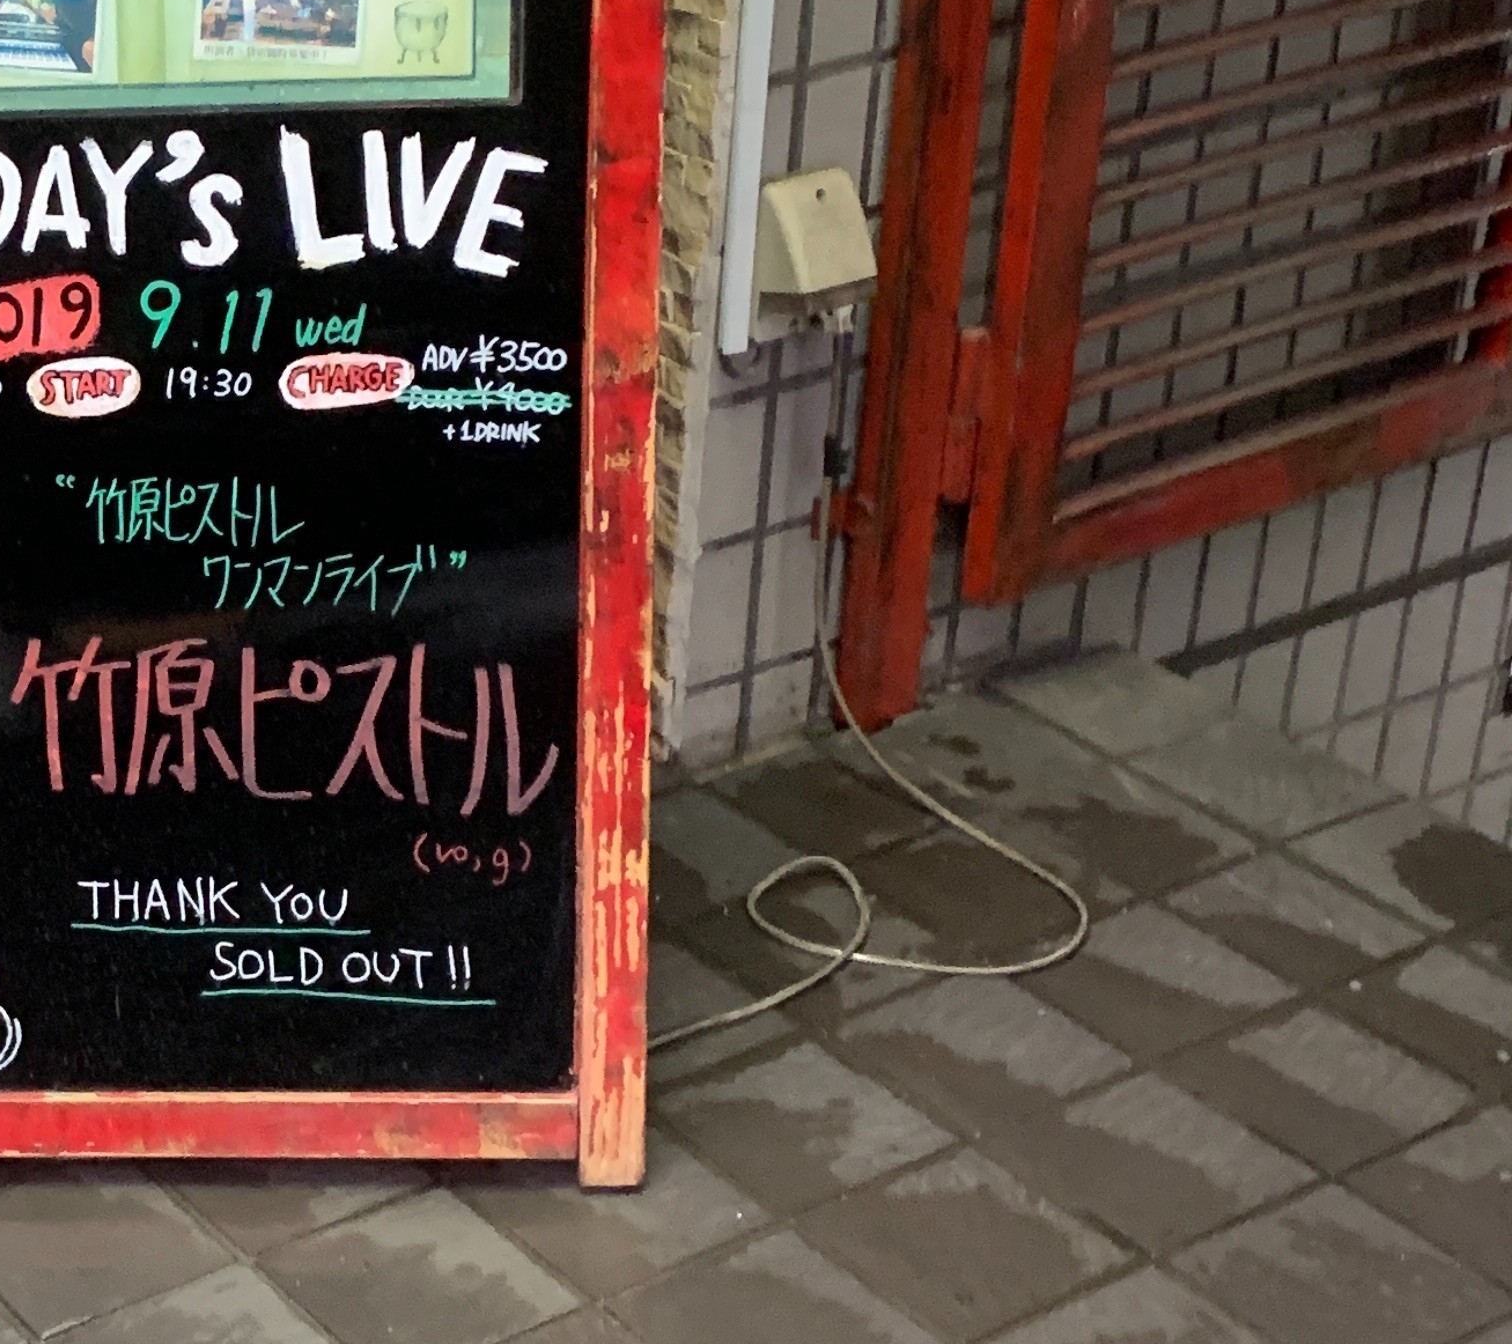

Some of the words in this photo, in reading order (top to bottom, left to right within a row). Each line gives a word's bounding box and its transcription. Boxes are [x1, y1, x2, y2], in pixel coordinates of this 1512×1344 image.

[280, 124, 549, 279] LIVE
[140, 279, 273, 355] 9.11
[295, 303, 365, 347] wed
[422, 343, 469, 373] ADV
[469, 334, 569, 374] ¥3500
[39, 368, 133, 407] START
[164, 366, 253, 399] 19:30
[286, 361, 404, 399] CHARGE
[9, 634, 560, 817] 竹原ピストル
[77, 877, 242, 925] THANK
[208, 941, 324, 985] SOLD
[341, 947, 434, 989] OUT
